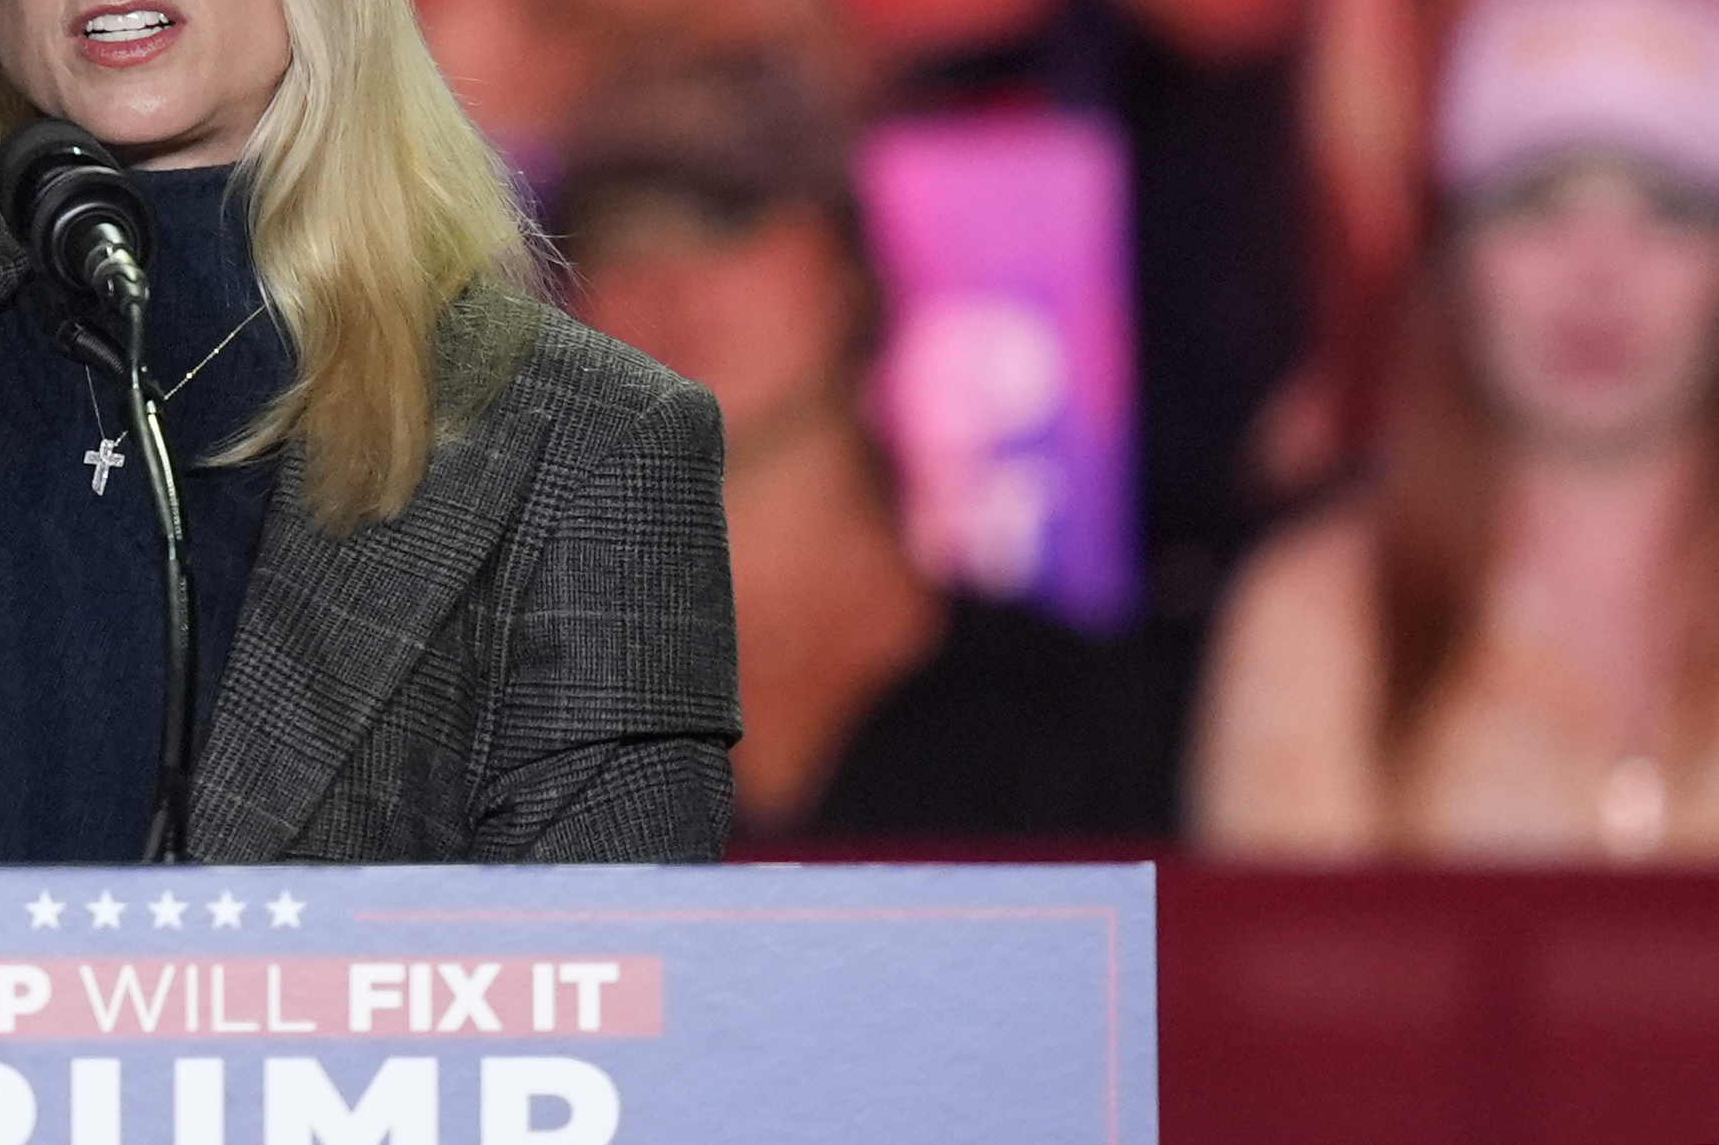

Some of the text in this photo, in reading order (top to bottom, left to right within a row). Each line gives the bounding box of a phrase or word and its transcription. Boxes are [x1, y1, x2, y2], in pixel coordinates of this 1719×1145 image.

[79, 963, 317, 1033] WILL
[348, 962, 503, 1033] FIX
[532, 962, 620, 1032] IT
